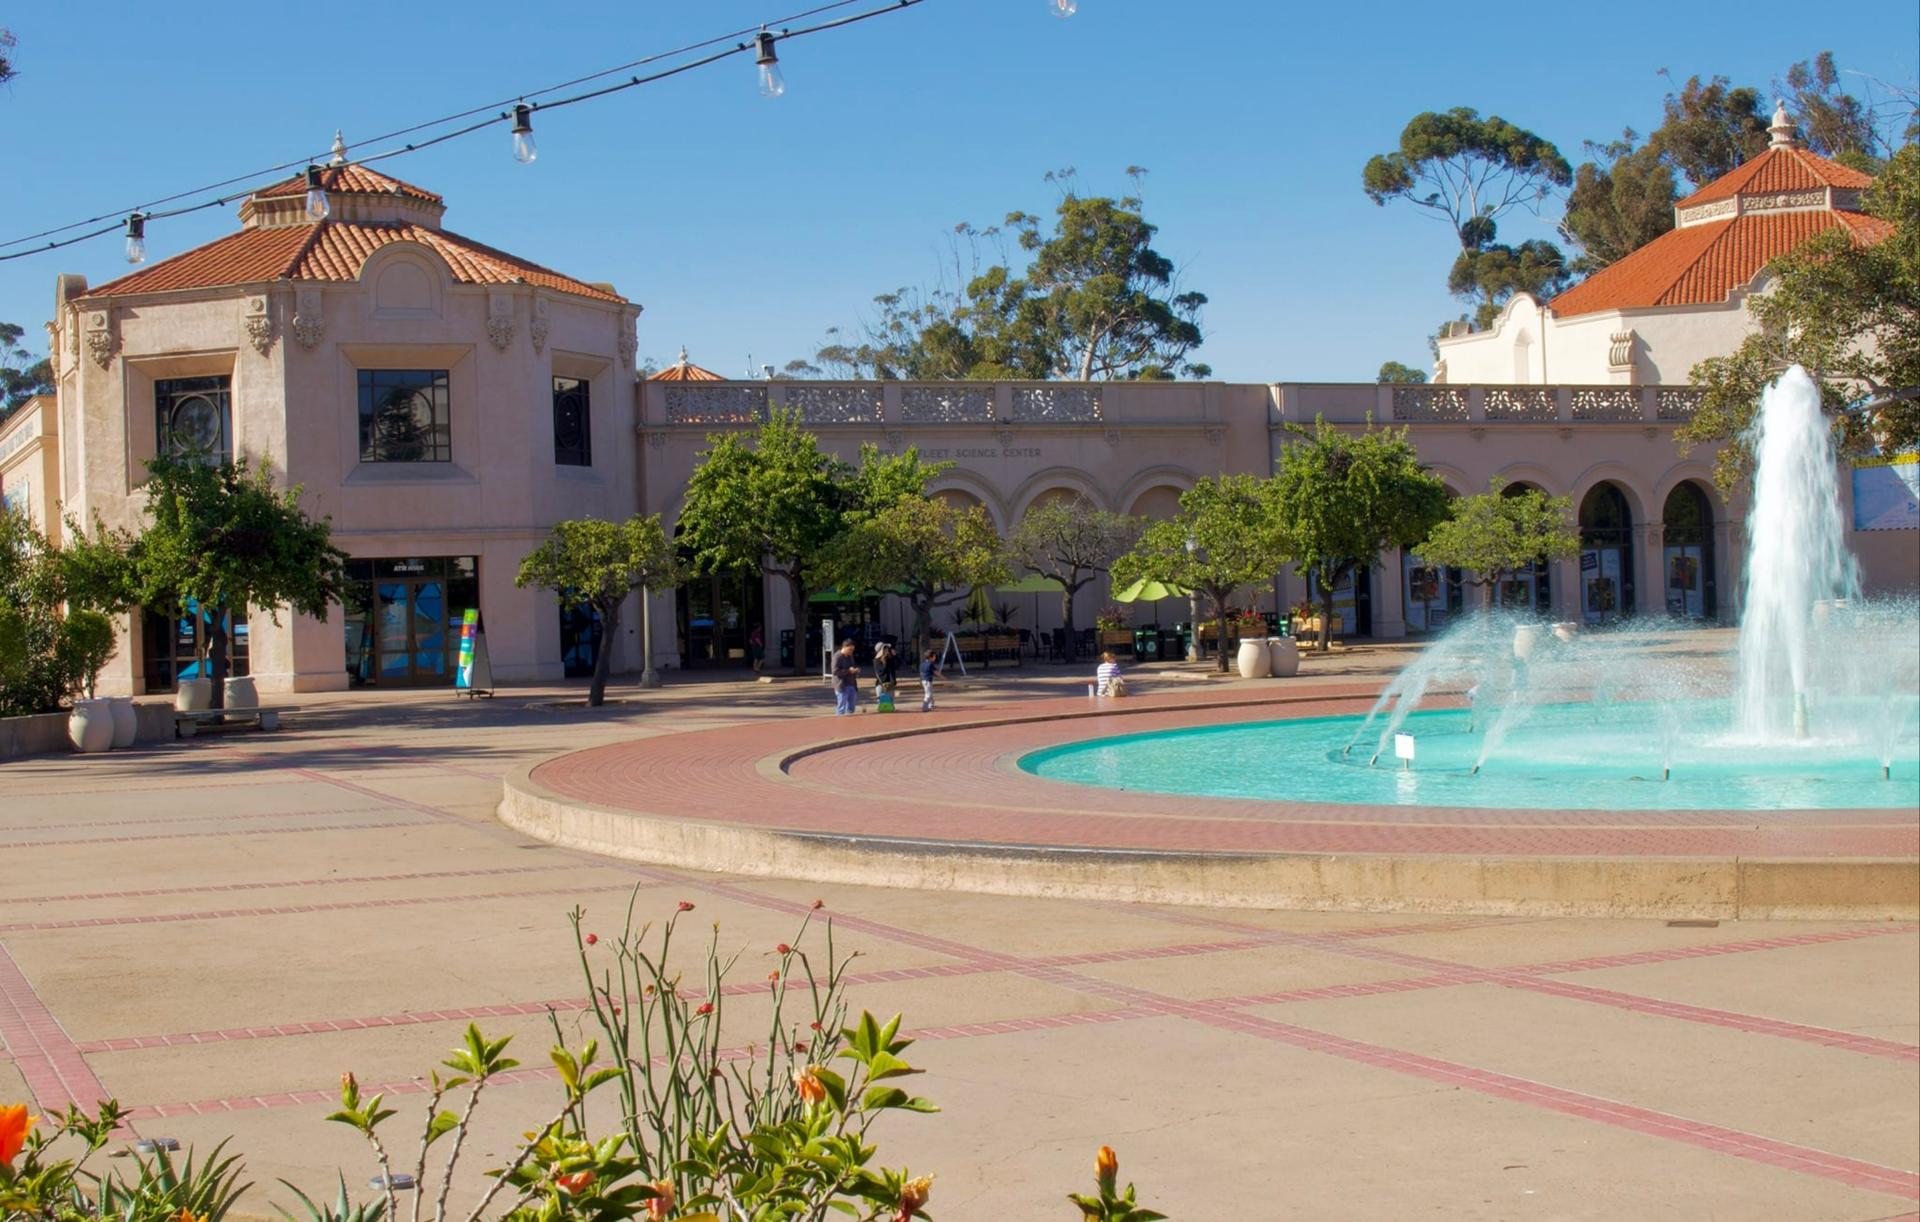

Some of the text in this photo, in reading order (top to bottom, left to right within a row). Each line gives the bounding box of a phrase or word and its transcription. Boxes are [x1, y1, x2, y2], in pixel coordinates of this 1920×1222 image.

[917, 448, 1042, 458] FLEET SCIENCE CENTER
